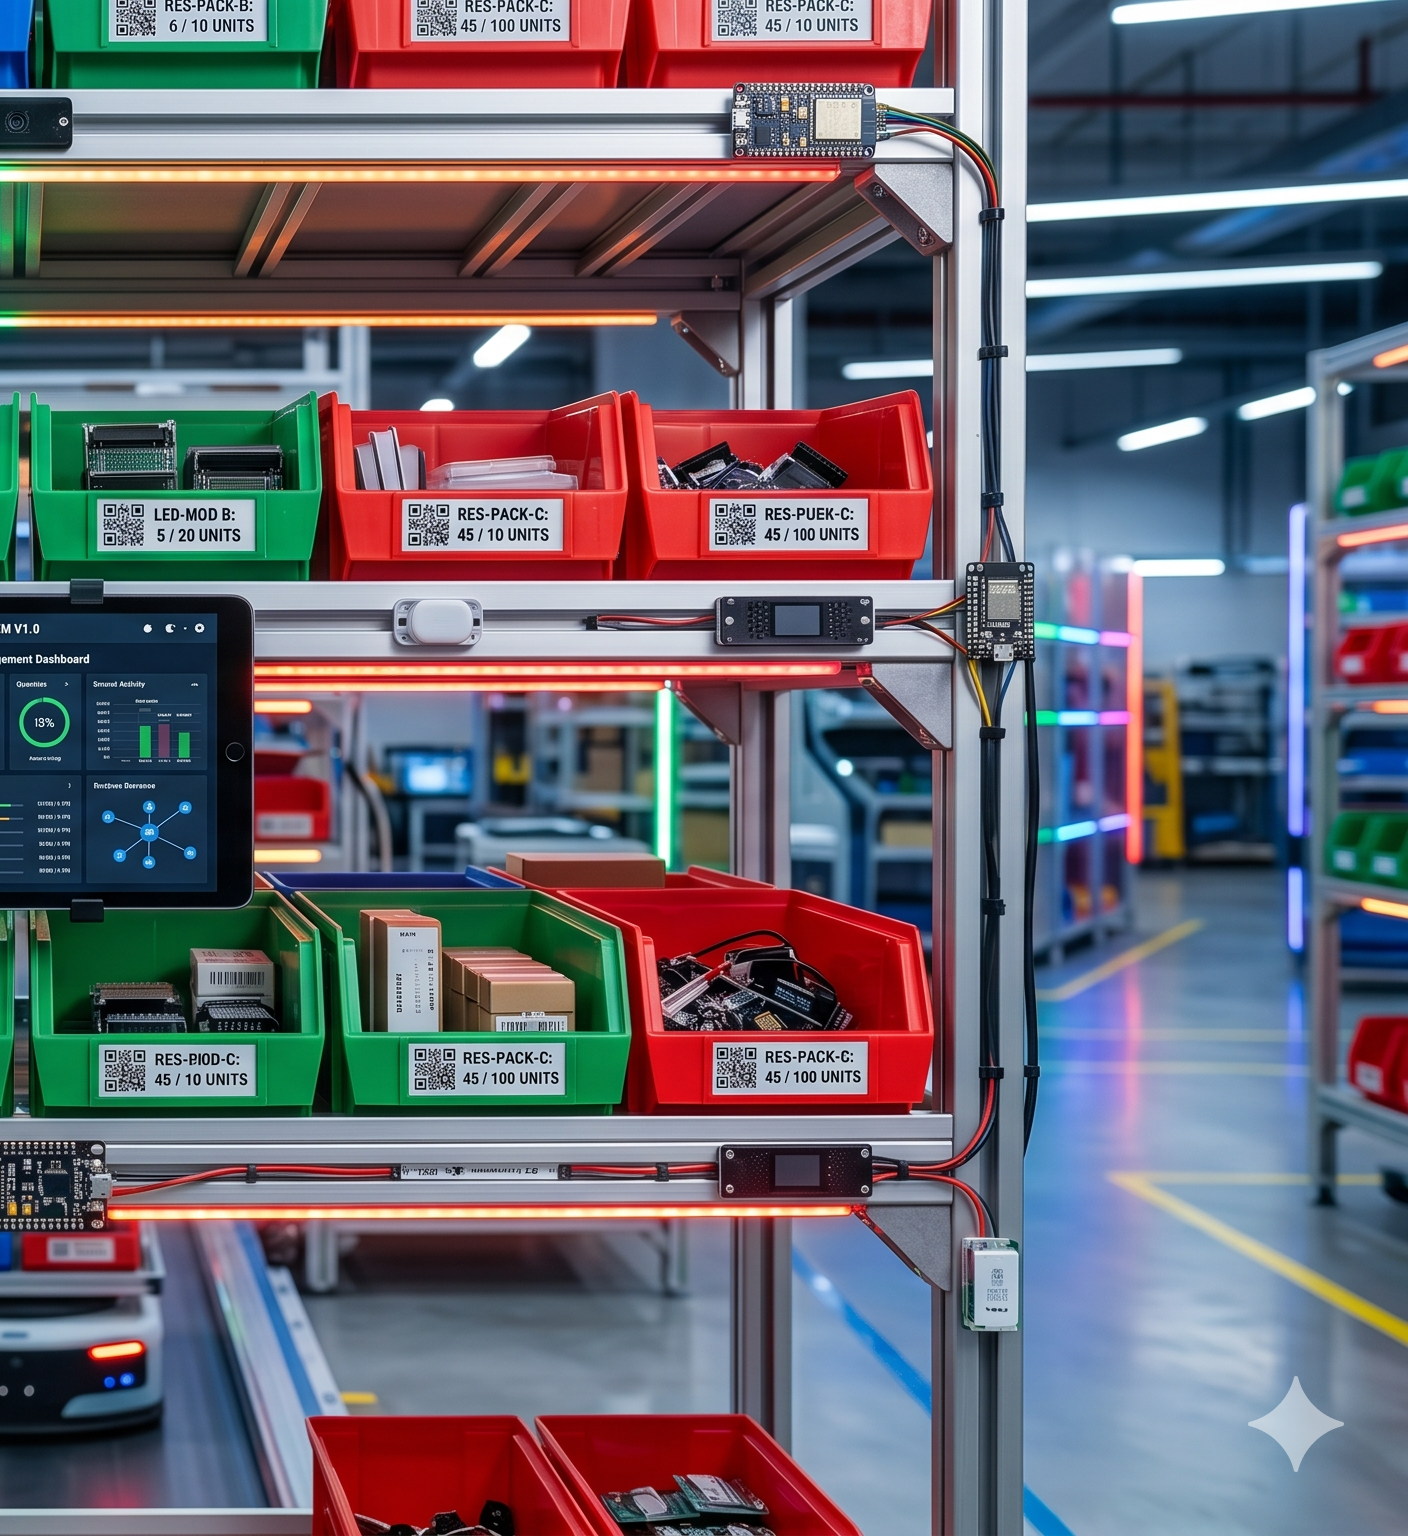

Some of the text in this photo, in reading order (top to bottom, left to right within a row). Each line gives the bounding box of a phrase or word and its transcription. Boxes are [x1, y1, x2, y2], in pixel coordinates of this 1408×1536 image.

[164, 0, 253, 13] RES-PACK-B:
[465, 0, 553, 13] RES-PACK-C:
[765, 0, 854, 13] RES-PACK-C:
[169, 18, 255, 33] 6 / 10 UNITS
[460, 18, 561, 33] 45 / 100 UNITS
[764, 17, 859, 33] 45 / 10 UNITS
[154, 507, 236, 522] LED-MOD B:
[457, 506, 549, 521] RES-PACK-C:
[765, 507, 854, 521] RES-PUEK-C:
[156, 528, 241, 543] 5 / 20 UNITS
[457, 527, 550, 542] 45 / 10 UNITS
[764, 527, 860, 542] 45 / 100 UNITS
[13, 622, 41, 636] V1.0
[35, 653, 90, 664] Dashboard
[463, 1051, 553, 1065] RES-PACK-C:
[765, 1049, 854, 1064] RES-PACK-C:
[154, 1072, 248, 1087] 45 / 10 UNITS
[462, 1071, 560, 1085] 45 / 100 UNITS
[764, 1069, 862, 1084] 45 / 100 UNITS
